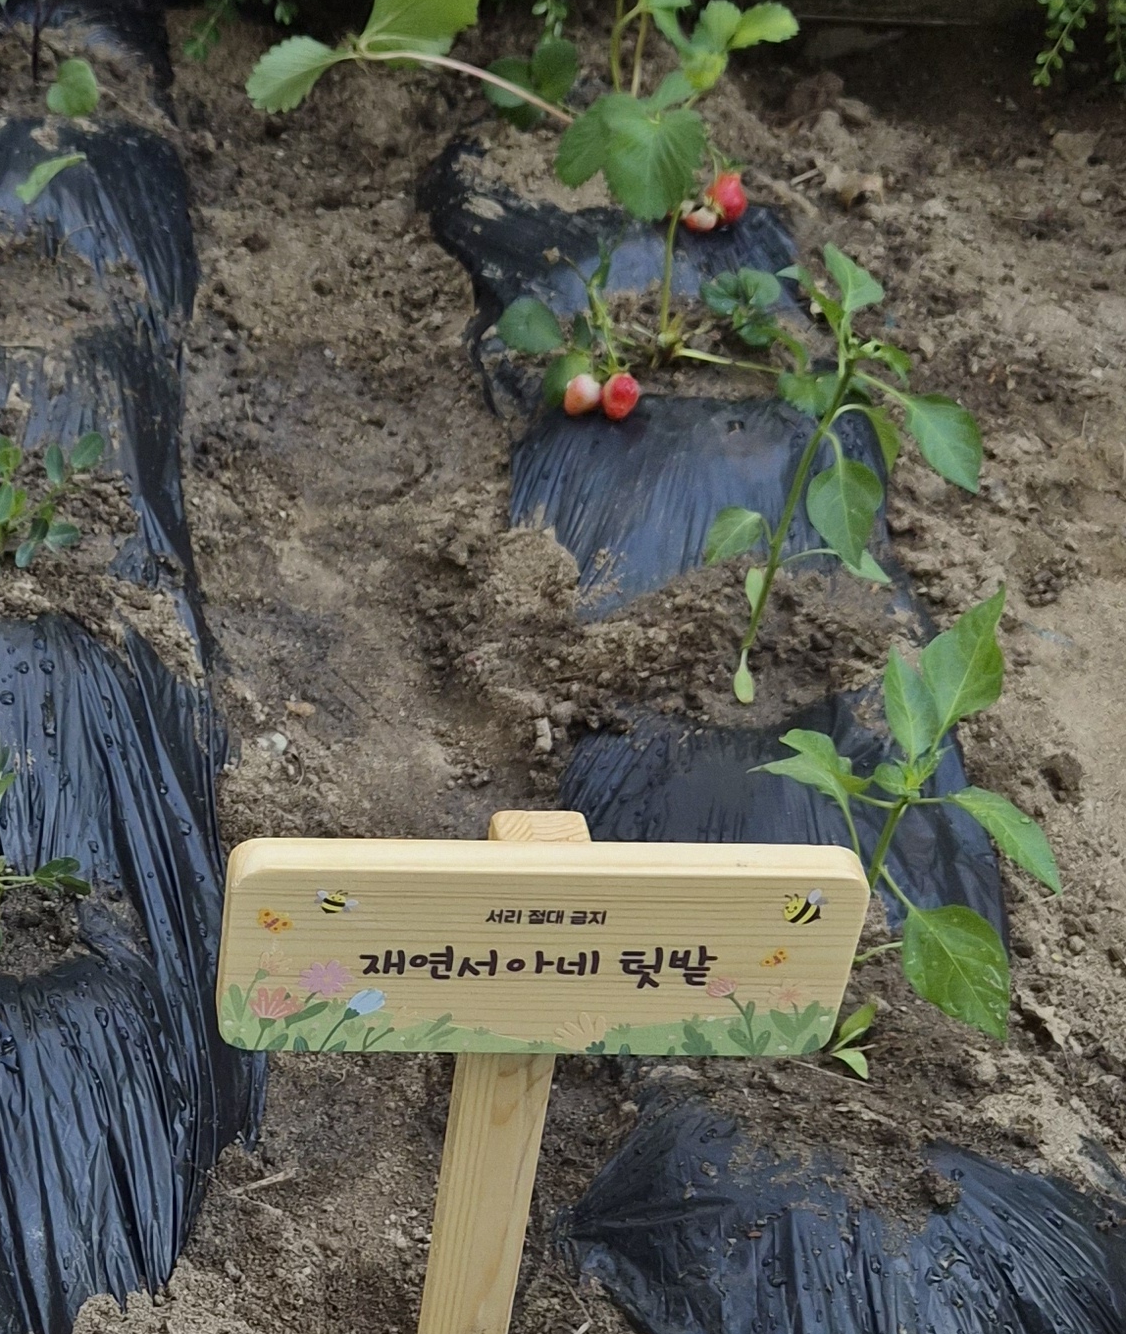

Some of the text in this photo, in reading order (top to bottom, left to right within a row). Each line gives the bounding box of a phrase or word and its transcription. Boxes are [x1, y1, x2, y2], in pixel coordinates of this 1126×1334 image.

[485, 909, 608, 926] 서리 절대 금지
[358, 945, 719, 989] 재연서아네 텃밭
